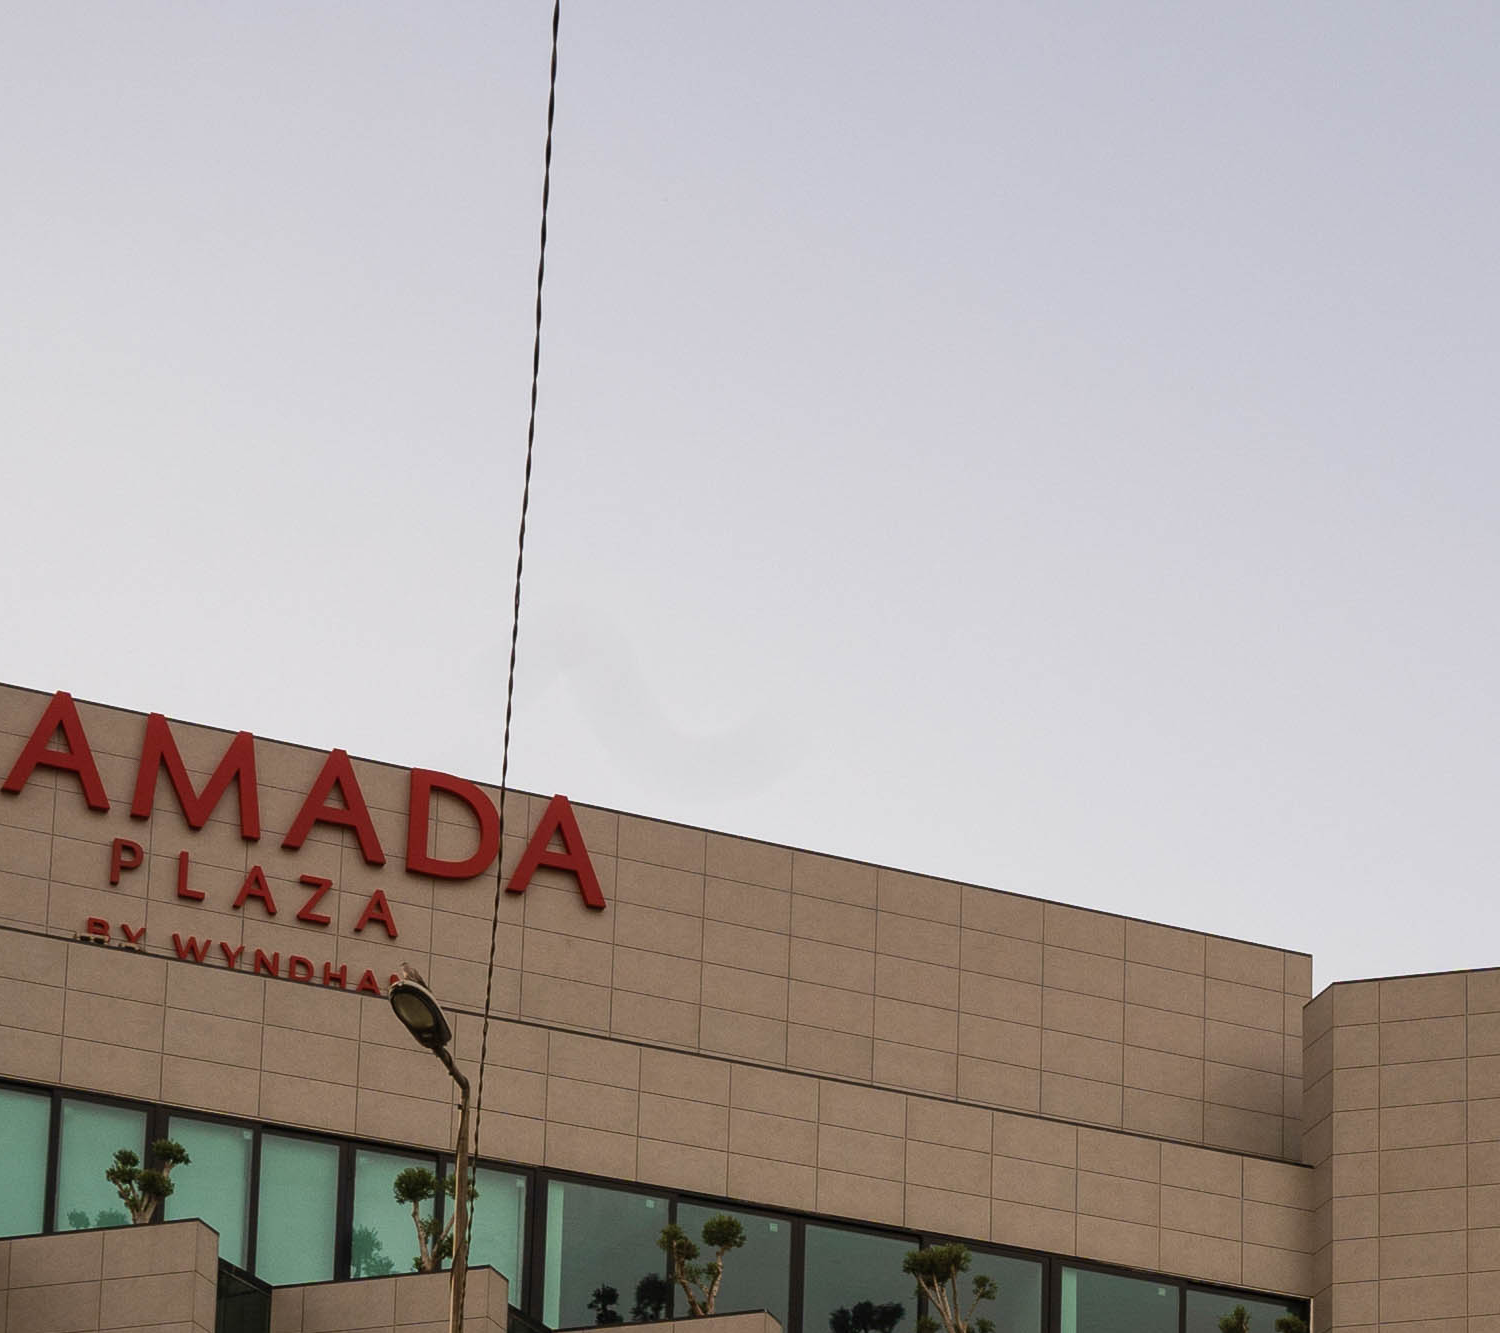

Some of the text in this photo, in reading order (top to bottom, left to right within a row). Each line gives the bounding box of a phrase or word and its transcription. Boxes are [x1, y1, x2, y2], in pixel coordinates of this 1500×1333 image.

[109, 837, 399, 938] PLAZA
[86, 916, 403, 996] BY WYNDHA
